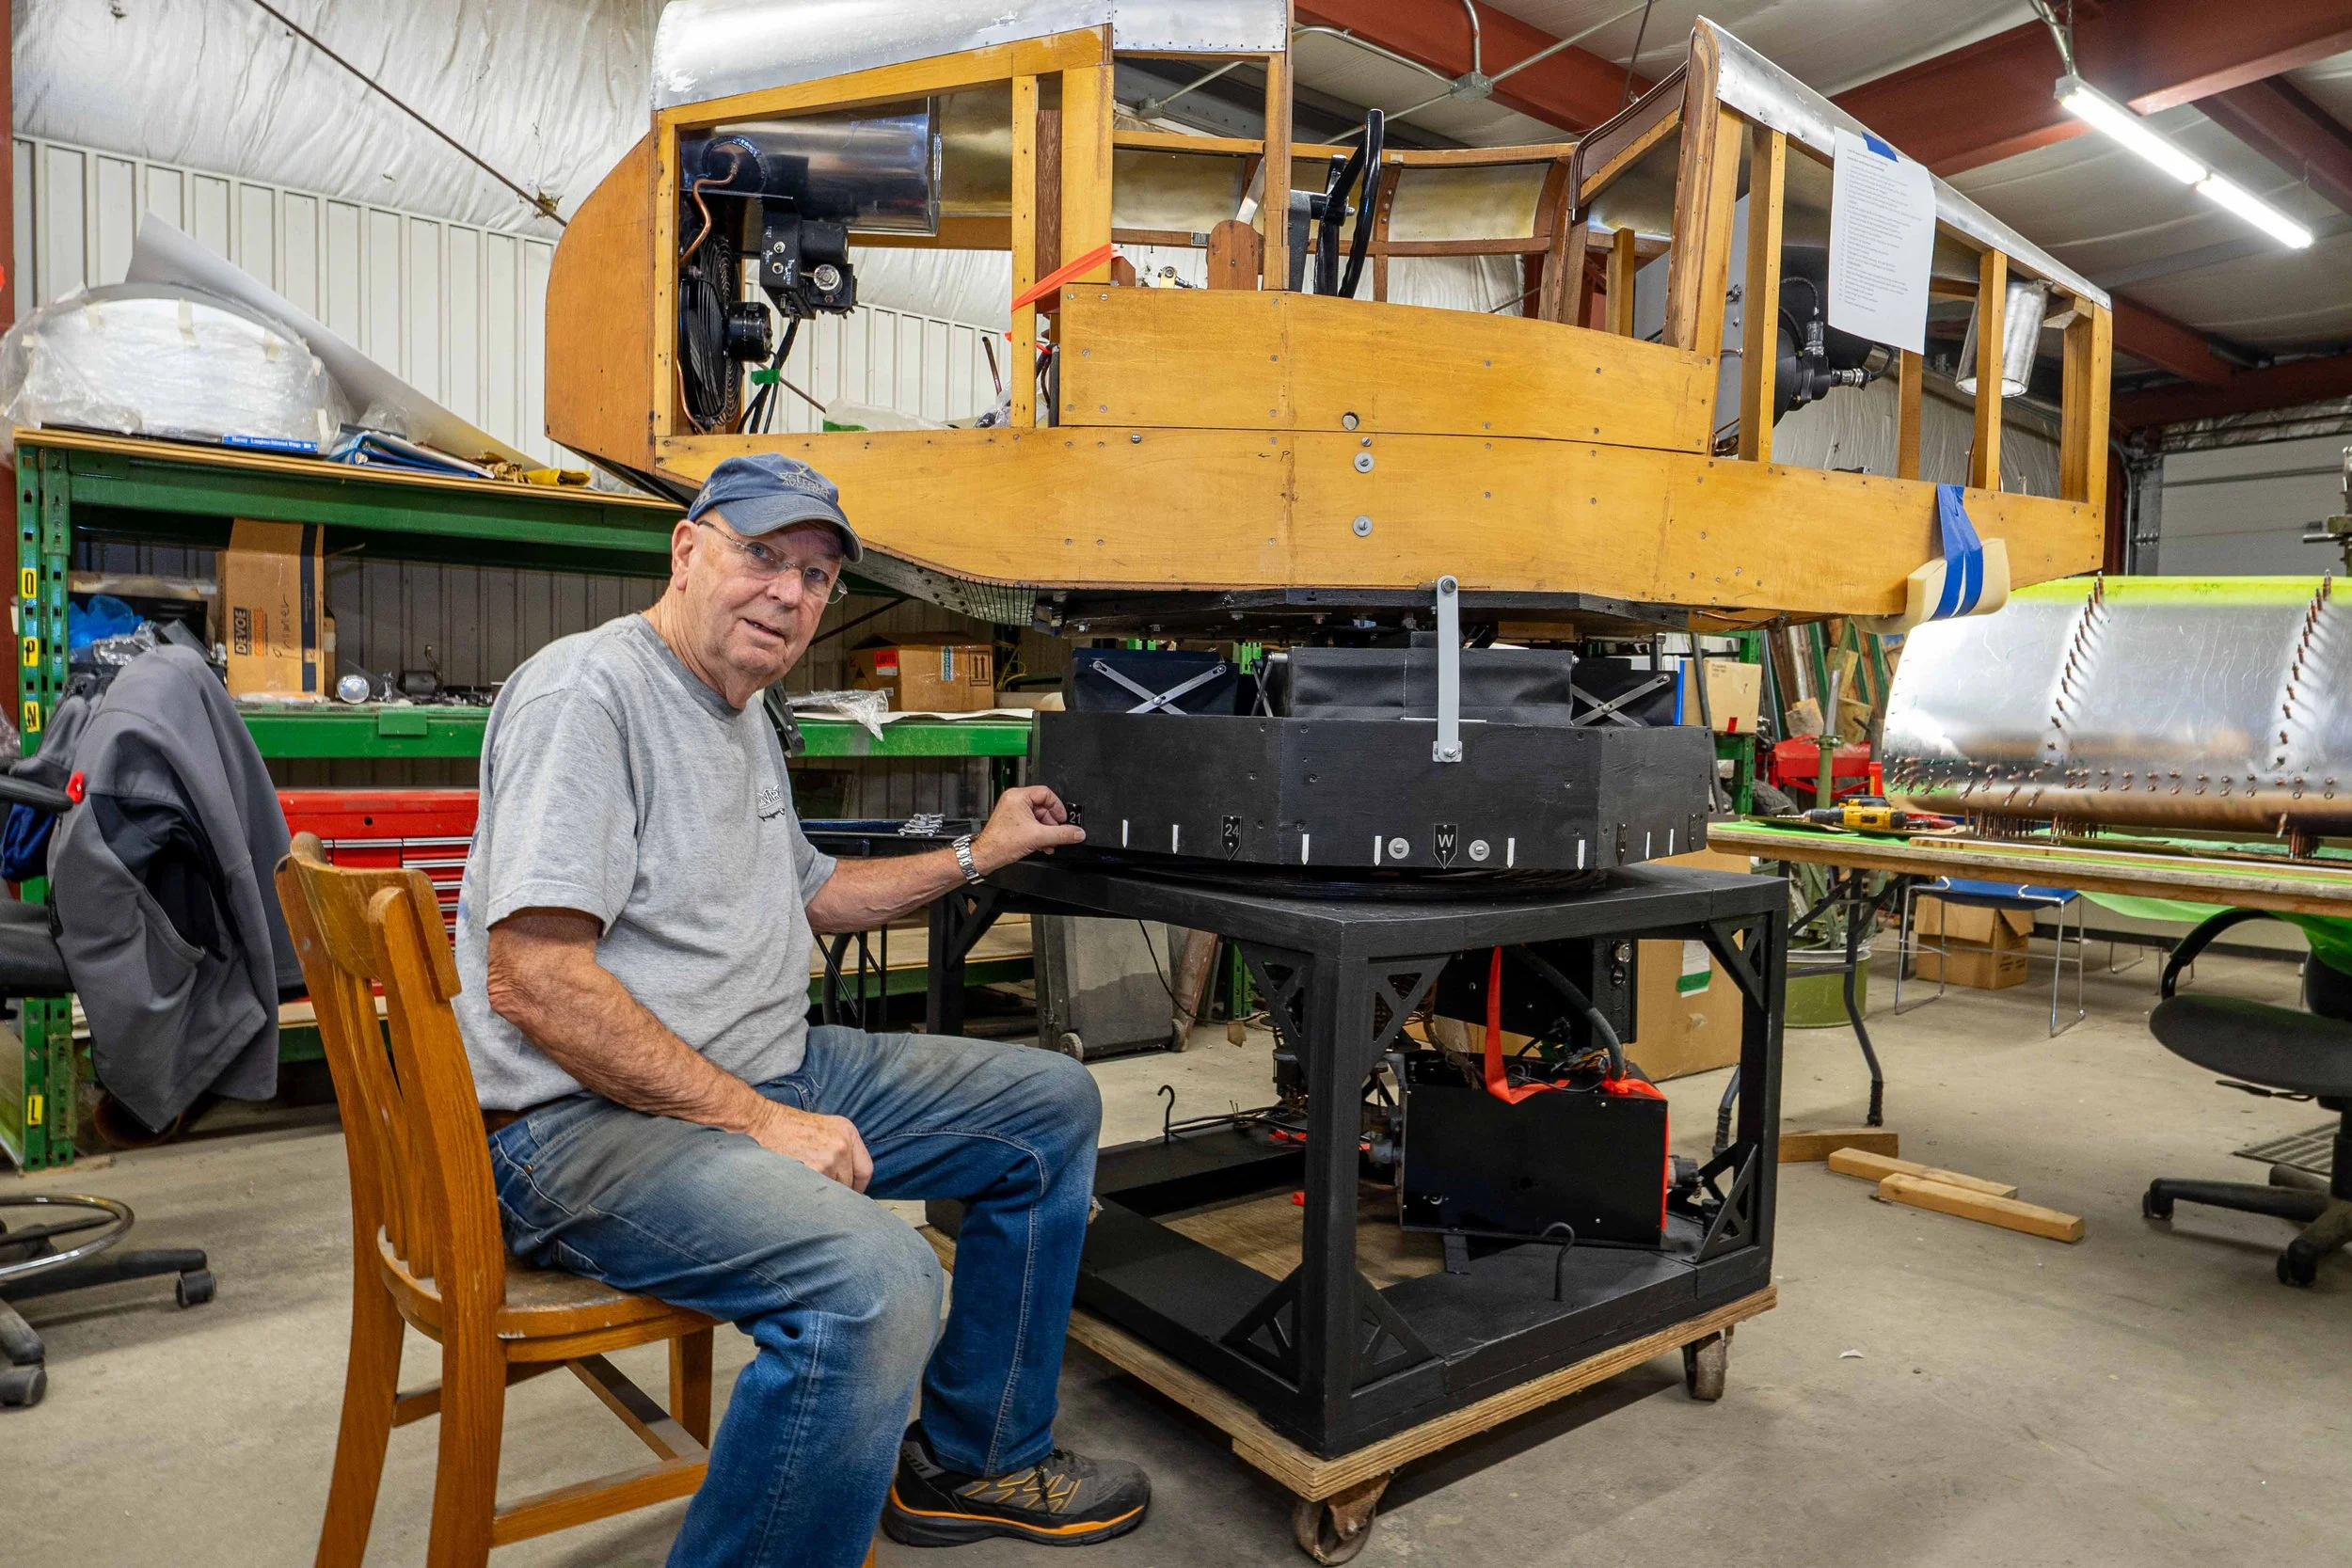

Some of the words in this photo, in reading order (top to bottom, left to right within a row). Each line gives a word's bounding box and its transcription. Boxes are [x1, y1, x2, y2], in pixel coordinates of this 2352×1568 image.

[235, 609, 246, 655] DEVOE
[25, 641, 36, 662] P
[876, 654, 897, 665] LIQUID
[26, 705, 37, 728] N
[1070, 811, 1081, 825] 21
[1224, 824, 1240, 838] 24
[1438, 834, 1454, 847] W
